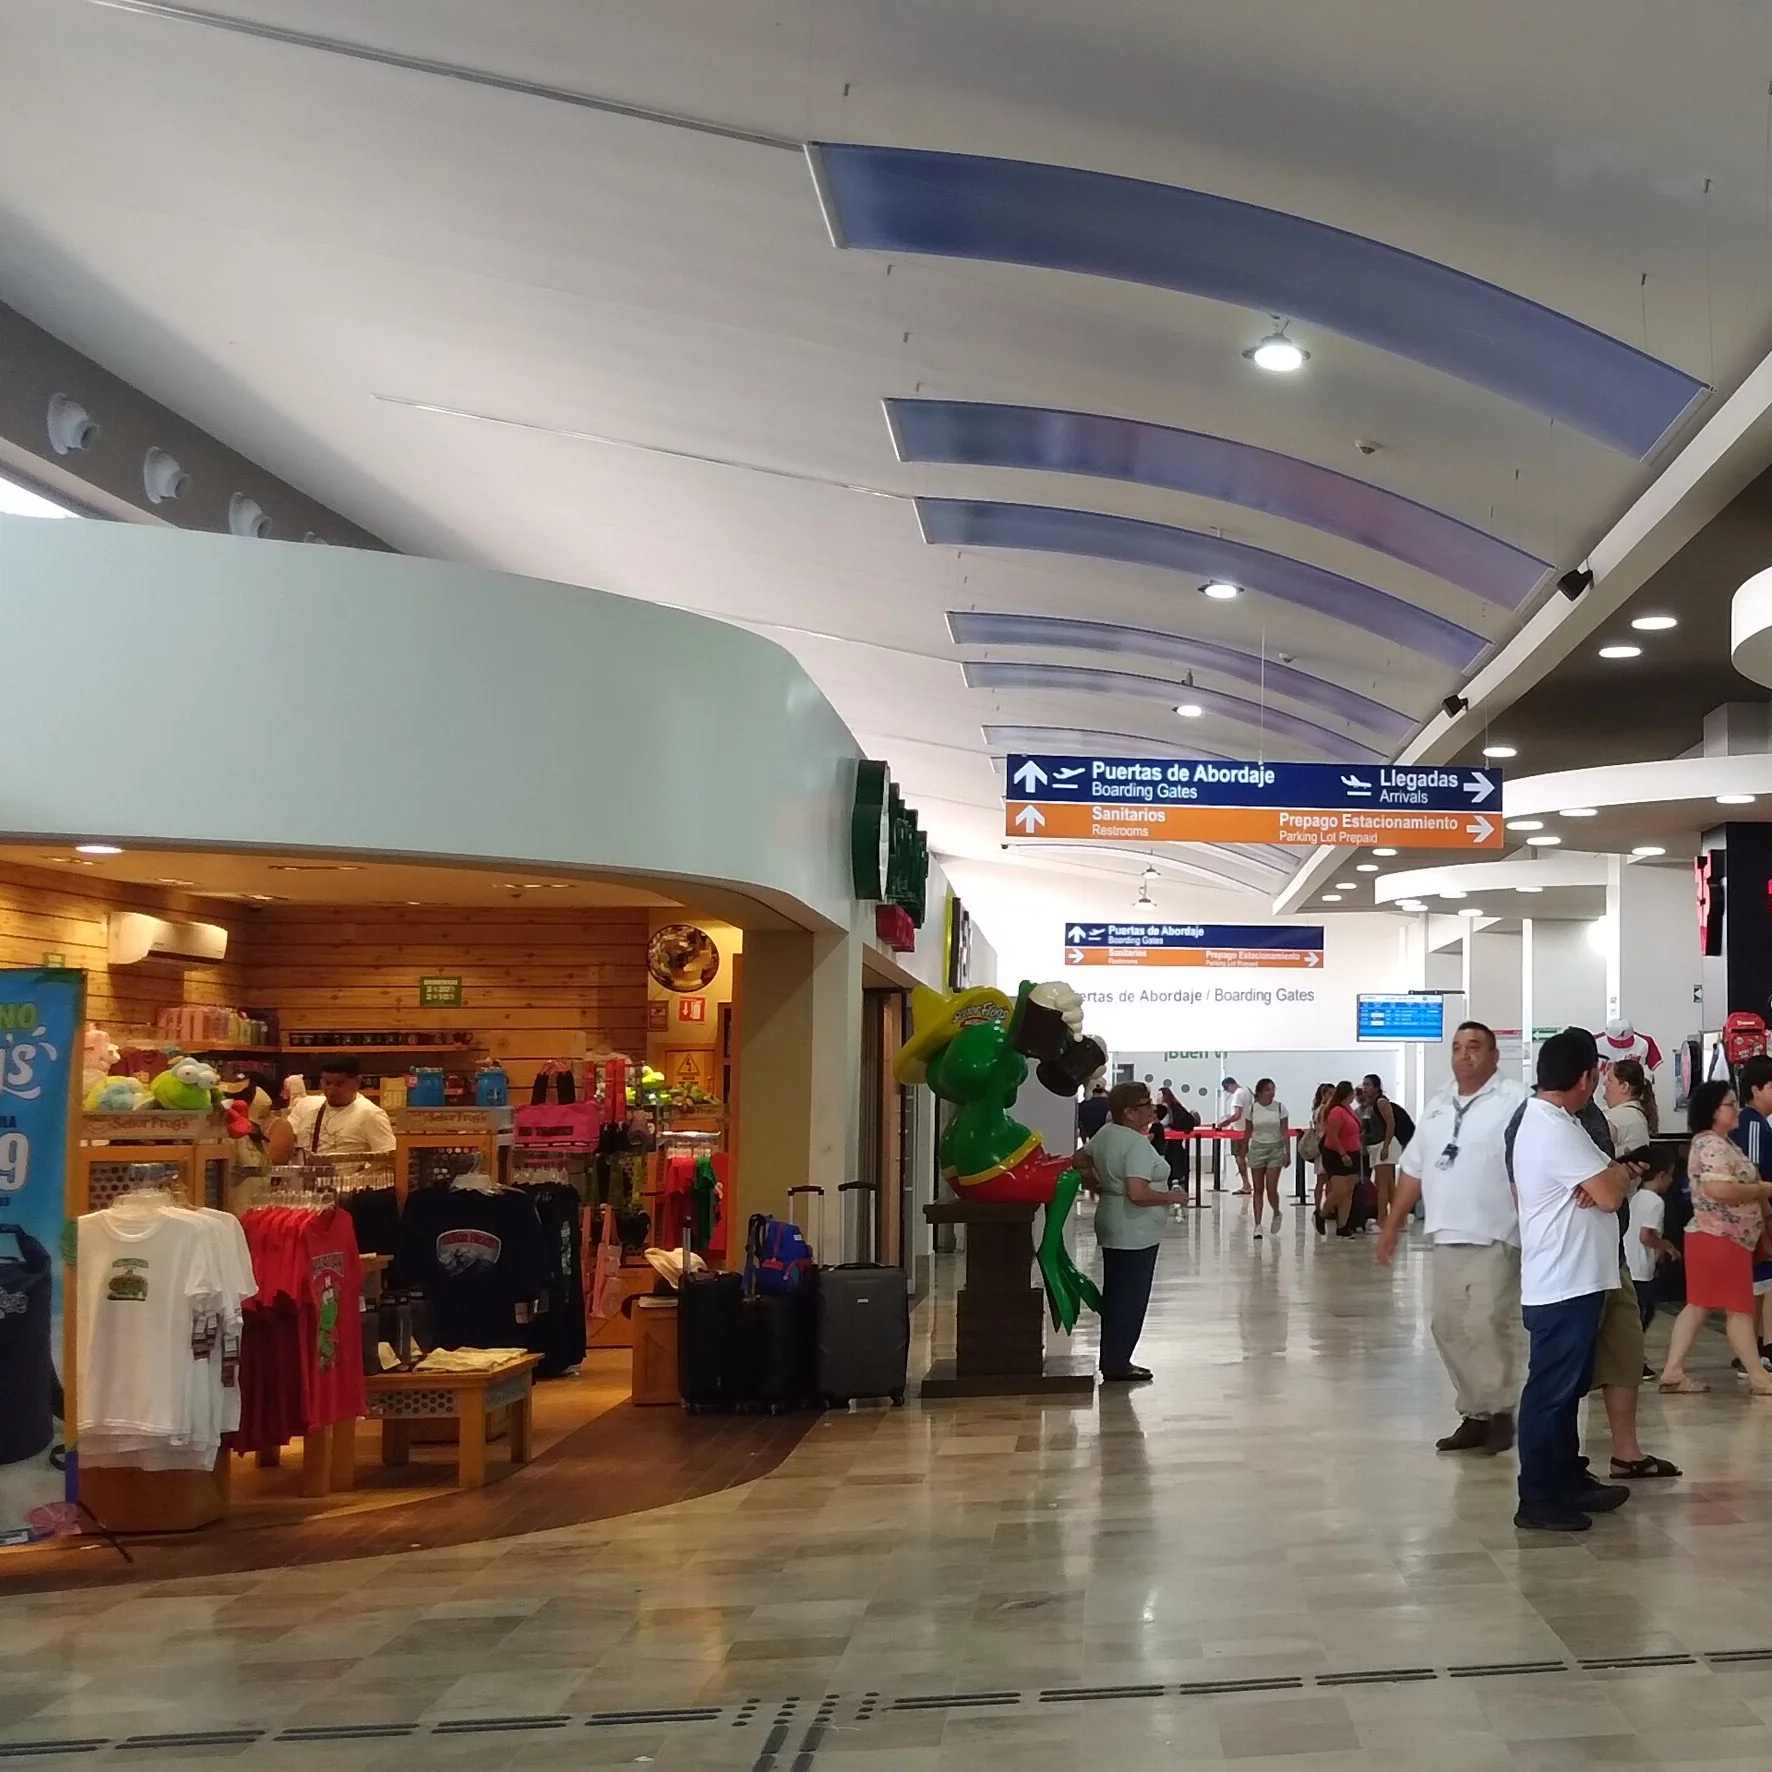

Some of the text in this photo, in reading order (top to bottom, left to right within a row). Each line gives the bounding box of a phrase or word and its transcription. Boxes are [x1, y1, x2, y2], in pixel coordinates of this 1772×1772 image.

[1092, 761, 1459, 791] Puertas de Abordaje Llegadas
[1092, 782, 1429, 804] Boarding Gates Arrivals
[1092, 806, 1458, 831] Sanitarios Prepago Estacionamiento
[1092, 824, 1378, 845] Restrooms Parking Lot Prepaid
[1108, 926, 1204, 938] Puertas de Abordaje
[1108, 936, 1164, 945] Boarding Gates
[1205, 951, 1237, 961] Prepago
[1238, 951, 1301, 961] Estacionamiento
[1119, 990, 1135, 1003] de
[1139, 989, 1202, 1004] Abordaje
[1215, 988, 1272, 1005] Boarding
[1275, 988, 1315, 1002] Gates
